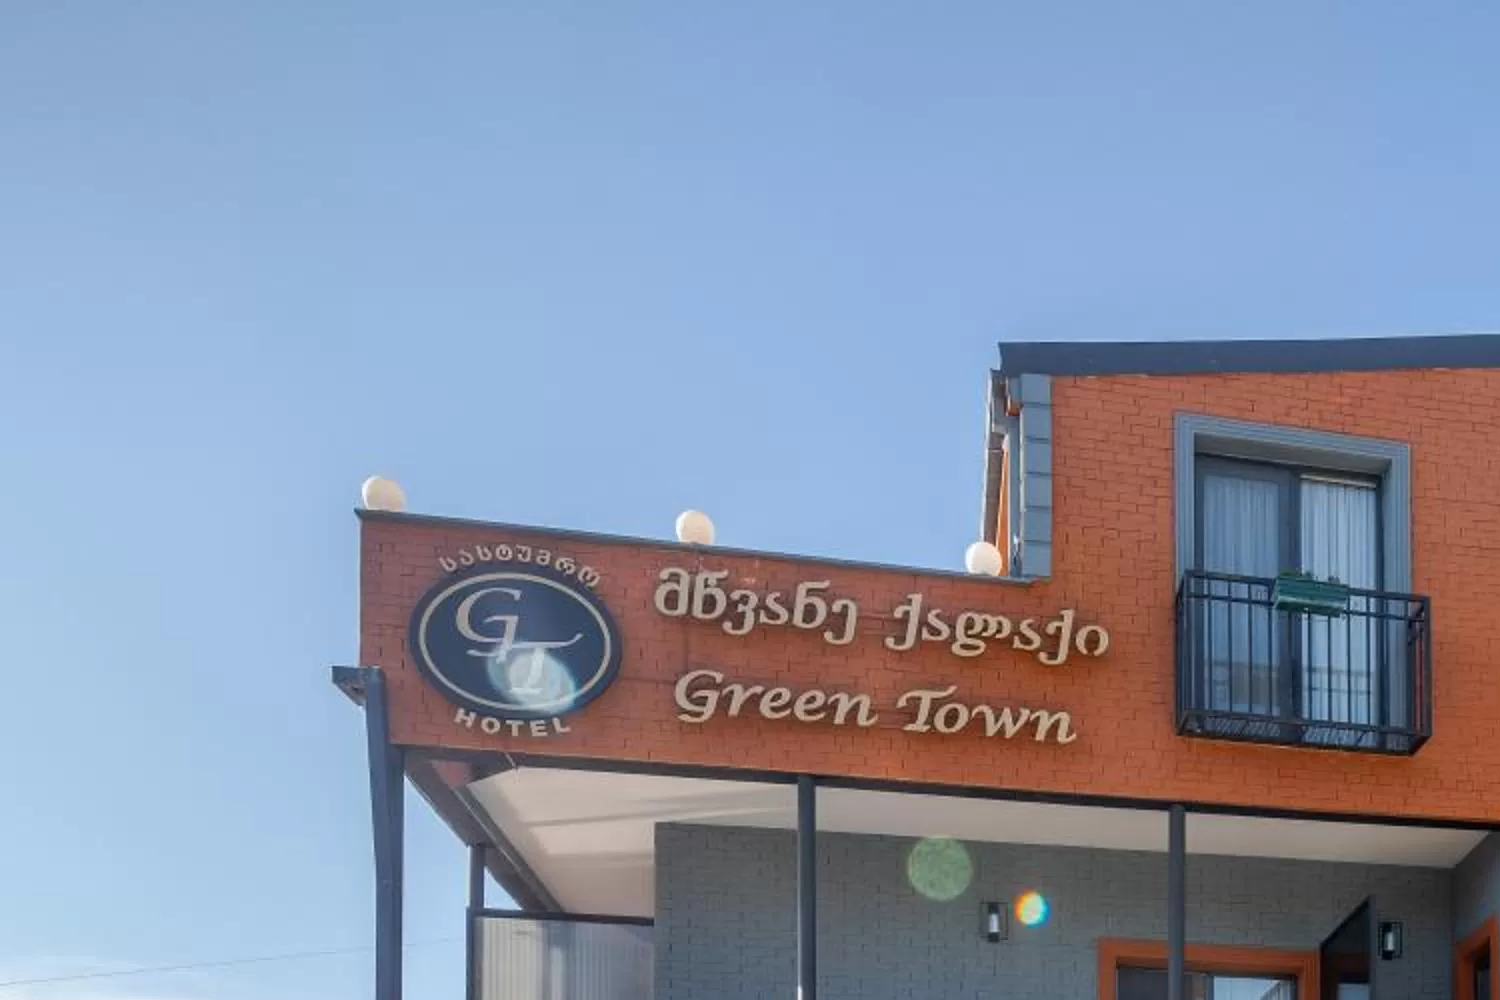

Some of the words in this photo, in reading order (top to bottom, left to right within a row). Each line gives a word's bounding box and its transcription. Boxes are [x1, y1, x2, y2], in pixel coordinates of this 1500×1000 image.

[437, 543, 602, 588] სასტუმრო
[653, 566, 859, 645] მწვანე
[884, 592, 1110, 666] ქალაქი
[453, 706, 573, 738] HOTEL
[674, 668, 880, 728] Green
[895, 685, 1078, 745] Town
